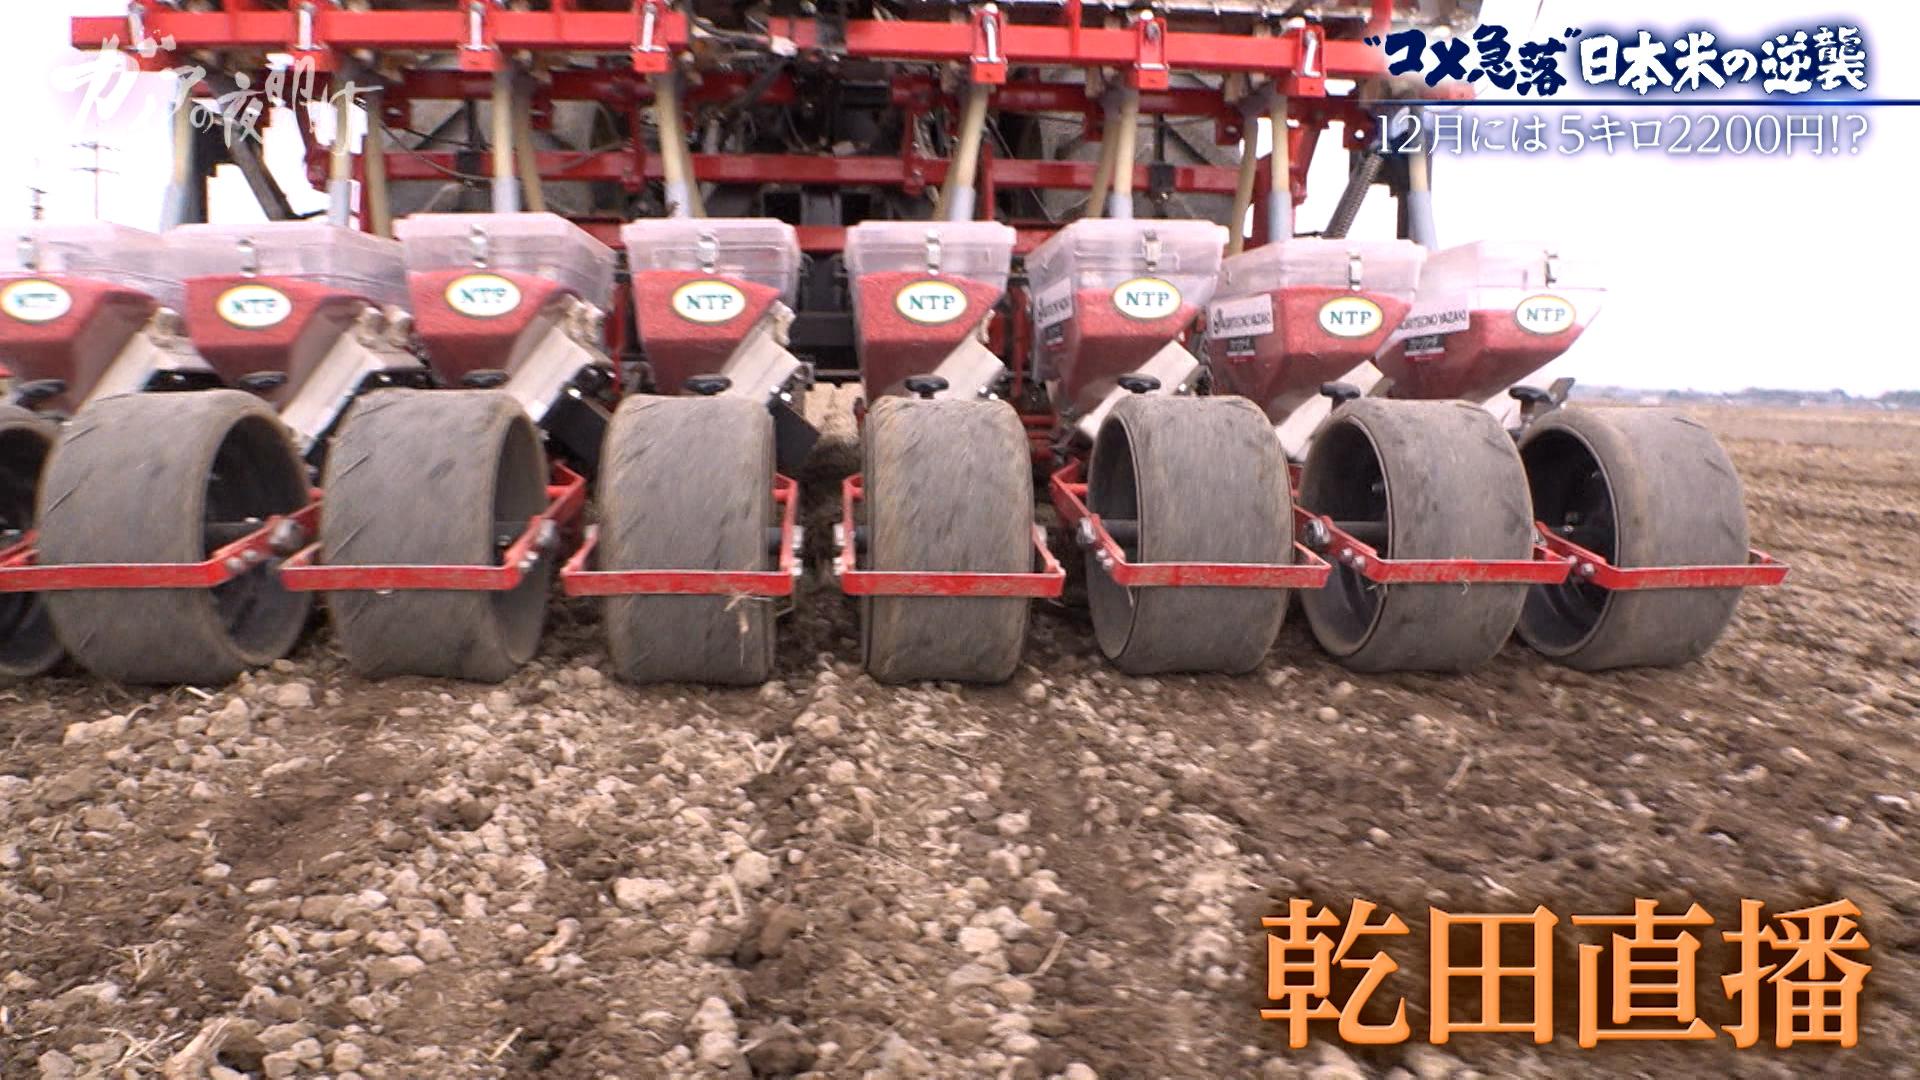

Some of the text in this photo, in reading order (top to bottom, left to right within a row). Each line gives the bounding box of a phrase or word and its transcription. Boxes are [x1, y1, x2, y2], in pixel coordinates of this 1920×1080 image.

[459, 286, 507, 303] NTP
[685, 294, 734, 310] NTP
[909, 294, 955, 310] NTP
[1125, 291, 1170, 307] NTP
[231, 297, 276, 314] NTP
[1329, 309, 1373, 325] NTP
[1525, 306, 1567, 322] NTP
